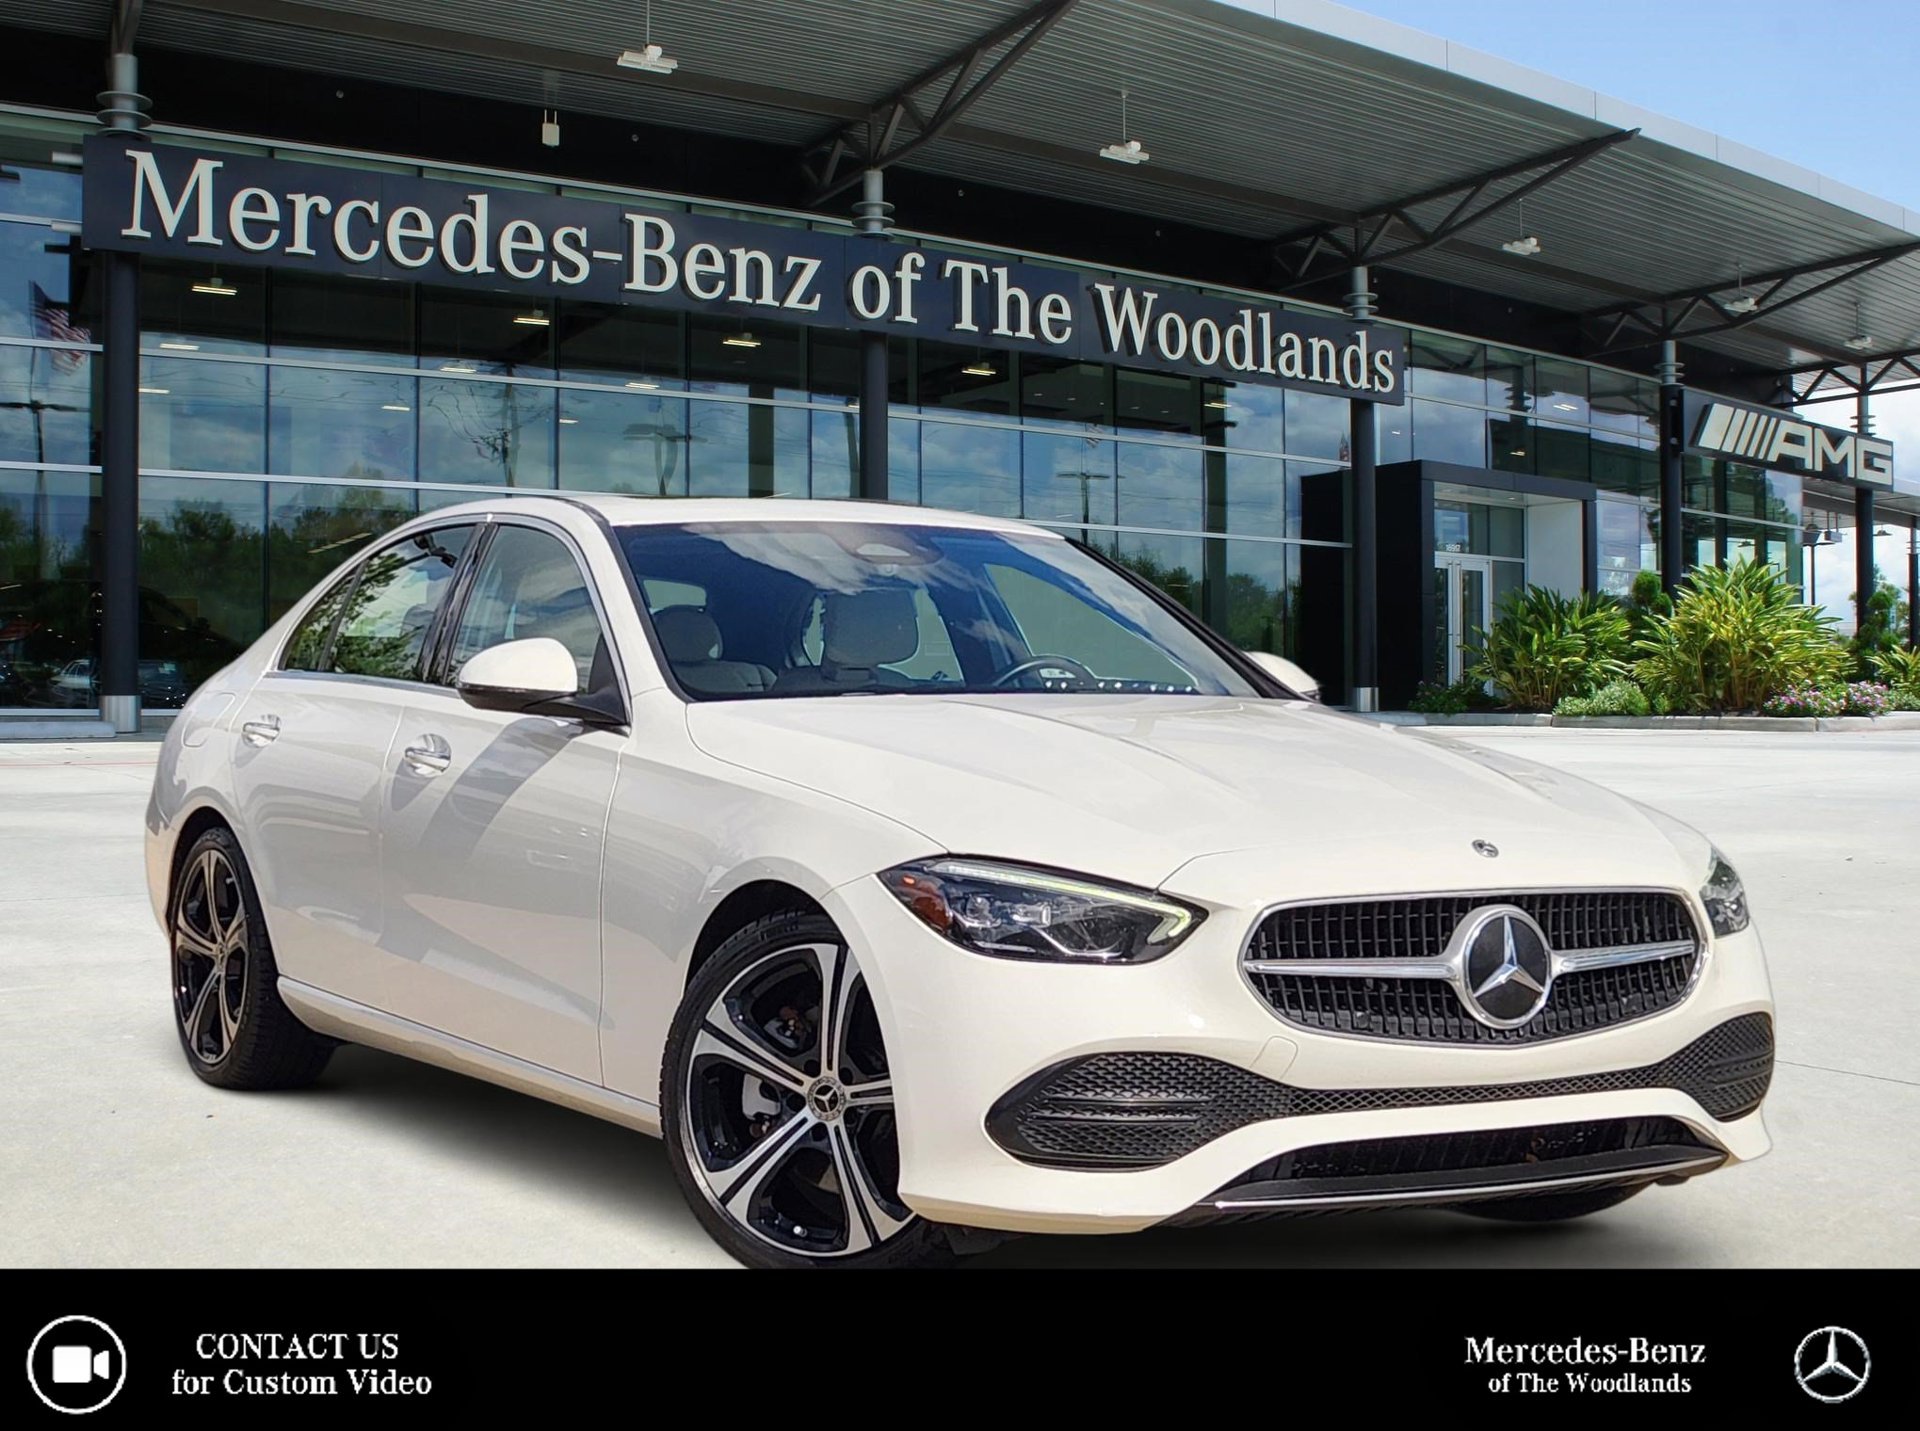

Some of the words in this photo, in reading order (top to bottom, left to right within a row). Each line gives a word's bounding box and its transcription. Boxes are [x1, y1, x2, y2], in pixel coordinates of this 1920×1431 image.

[121, 149, 822, 311] Mercedes-Benz
[850, 252, 926, 324] of
[944, 259, 1073, 345] The
[1093, 283, 1395, 393] Woodlands
[1766, 419, 1893, 486] AMG
